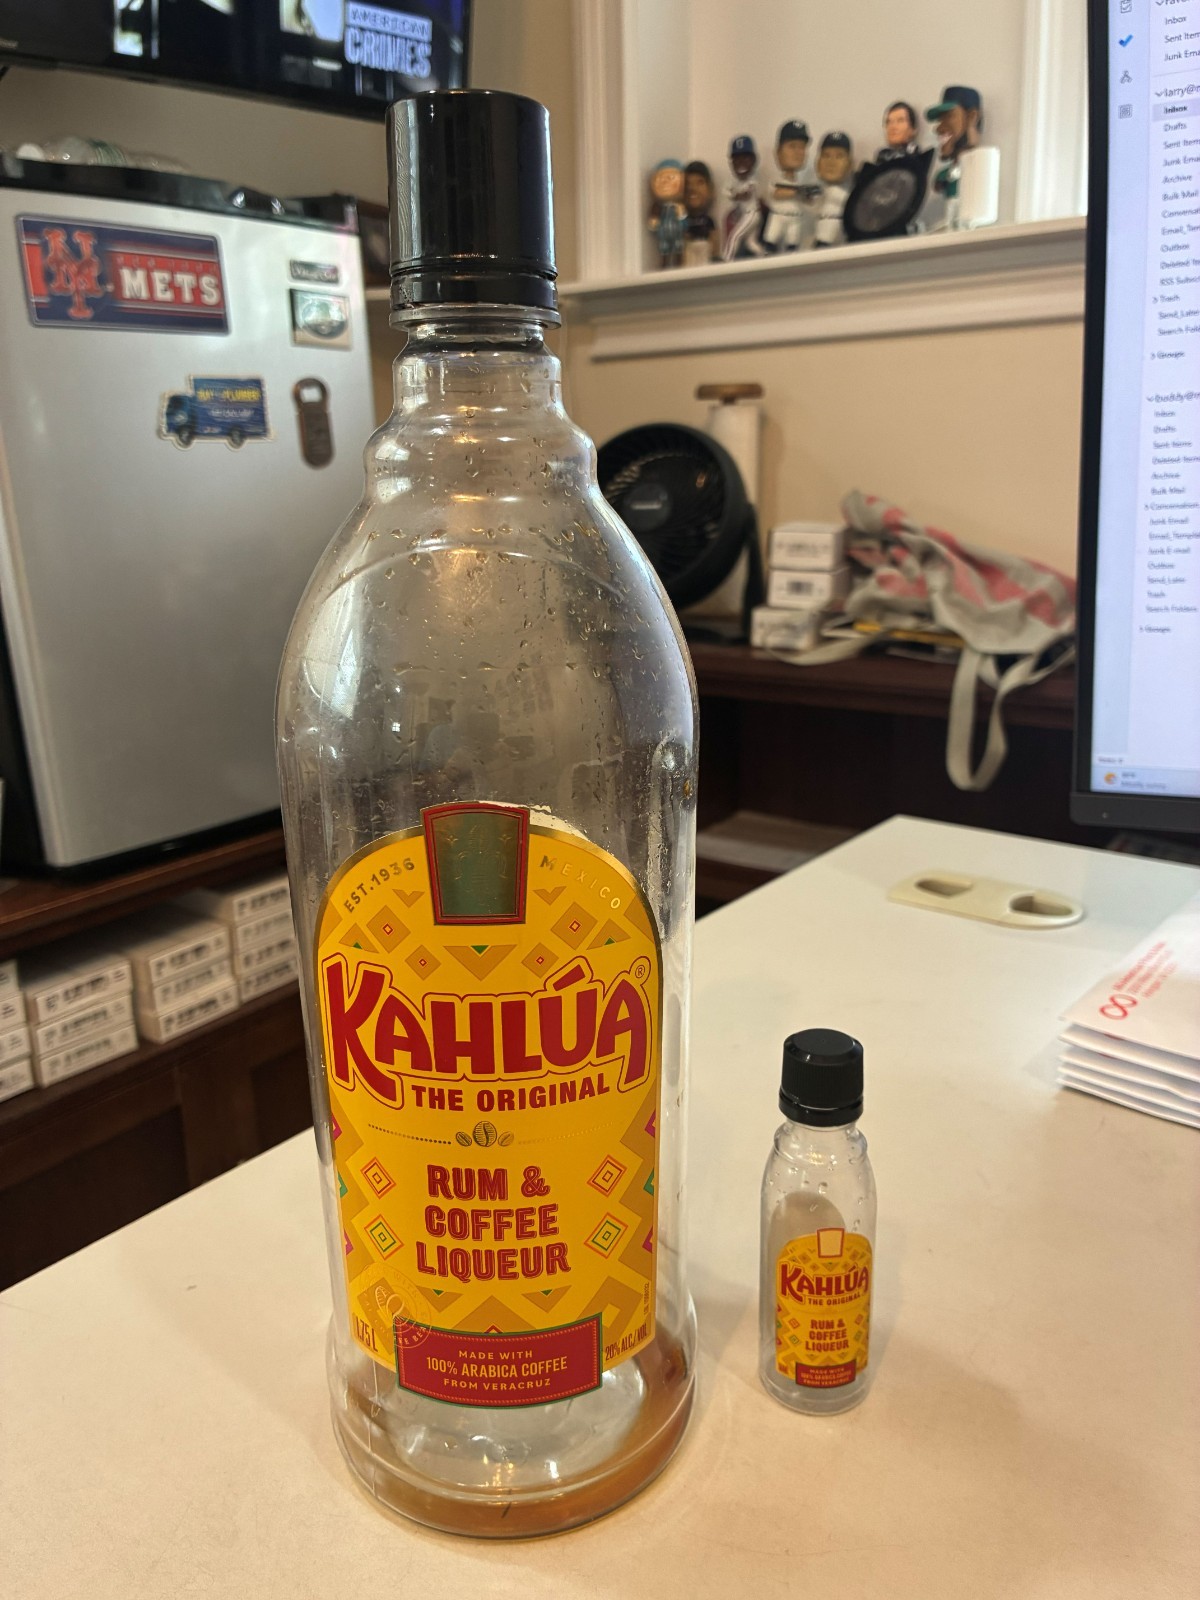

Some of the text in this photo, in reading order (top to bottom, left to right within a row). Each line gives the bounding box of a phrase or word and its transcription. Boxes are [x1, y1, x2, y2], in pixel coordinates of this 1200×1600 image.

[1165, 16, 1187, 25] Inbox
[1164, 34, 1182, 43] Sent
[345, 27, 432, 78] CRIMES
[1164, 51, 1182, 61] Junk
[1164, 105, 1187, 114] Inbox
[119, 265, 220, 306] METS
[539, 855, 622, 910] MEXICO
[411, 1072, 610, 1112] THE ORIGINAL
[427, 1164, 550, 1201] RUM &
[424, 1203, 560, 1242] COFFEE
[415, 1242, 572, 1283] LIQUEUR
[781, 1263, 869, 1302] KAHLÚA
[808, 1291, 861, 1306] THE ORIGINAL
[810, 1318, 846, 1330] RUM &
[809, 1328, 847, 1341] COFFEE
[605, 1342, 621, 1361] 20%
[805, 1339, 850, 1352] LIQUEUR
[458, 1350, 533, 1360] MADE WITH
[426, 1356, 568, 1378] 100% ARABICA COFFEE
[443, 1378, 551, 1391] FROM VERACRUZ
